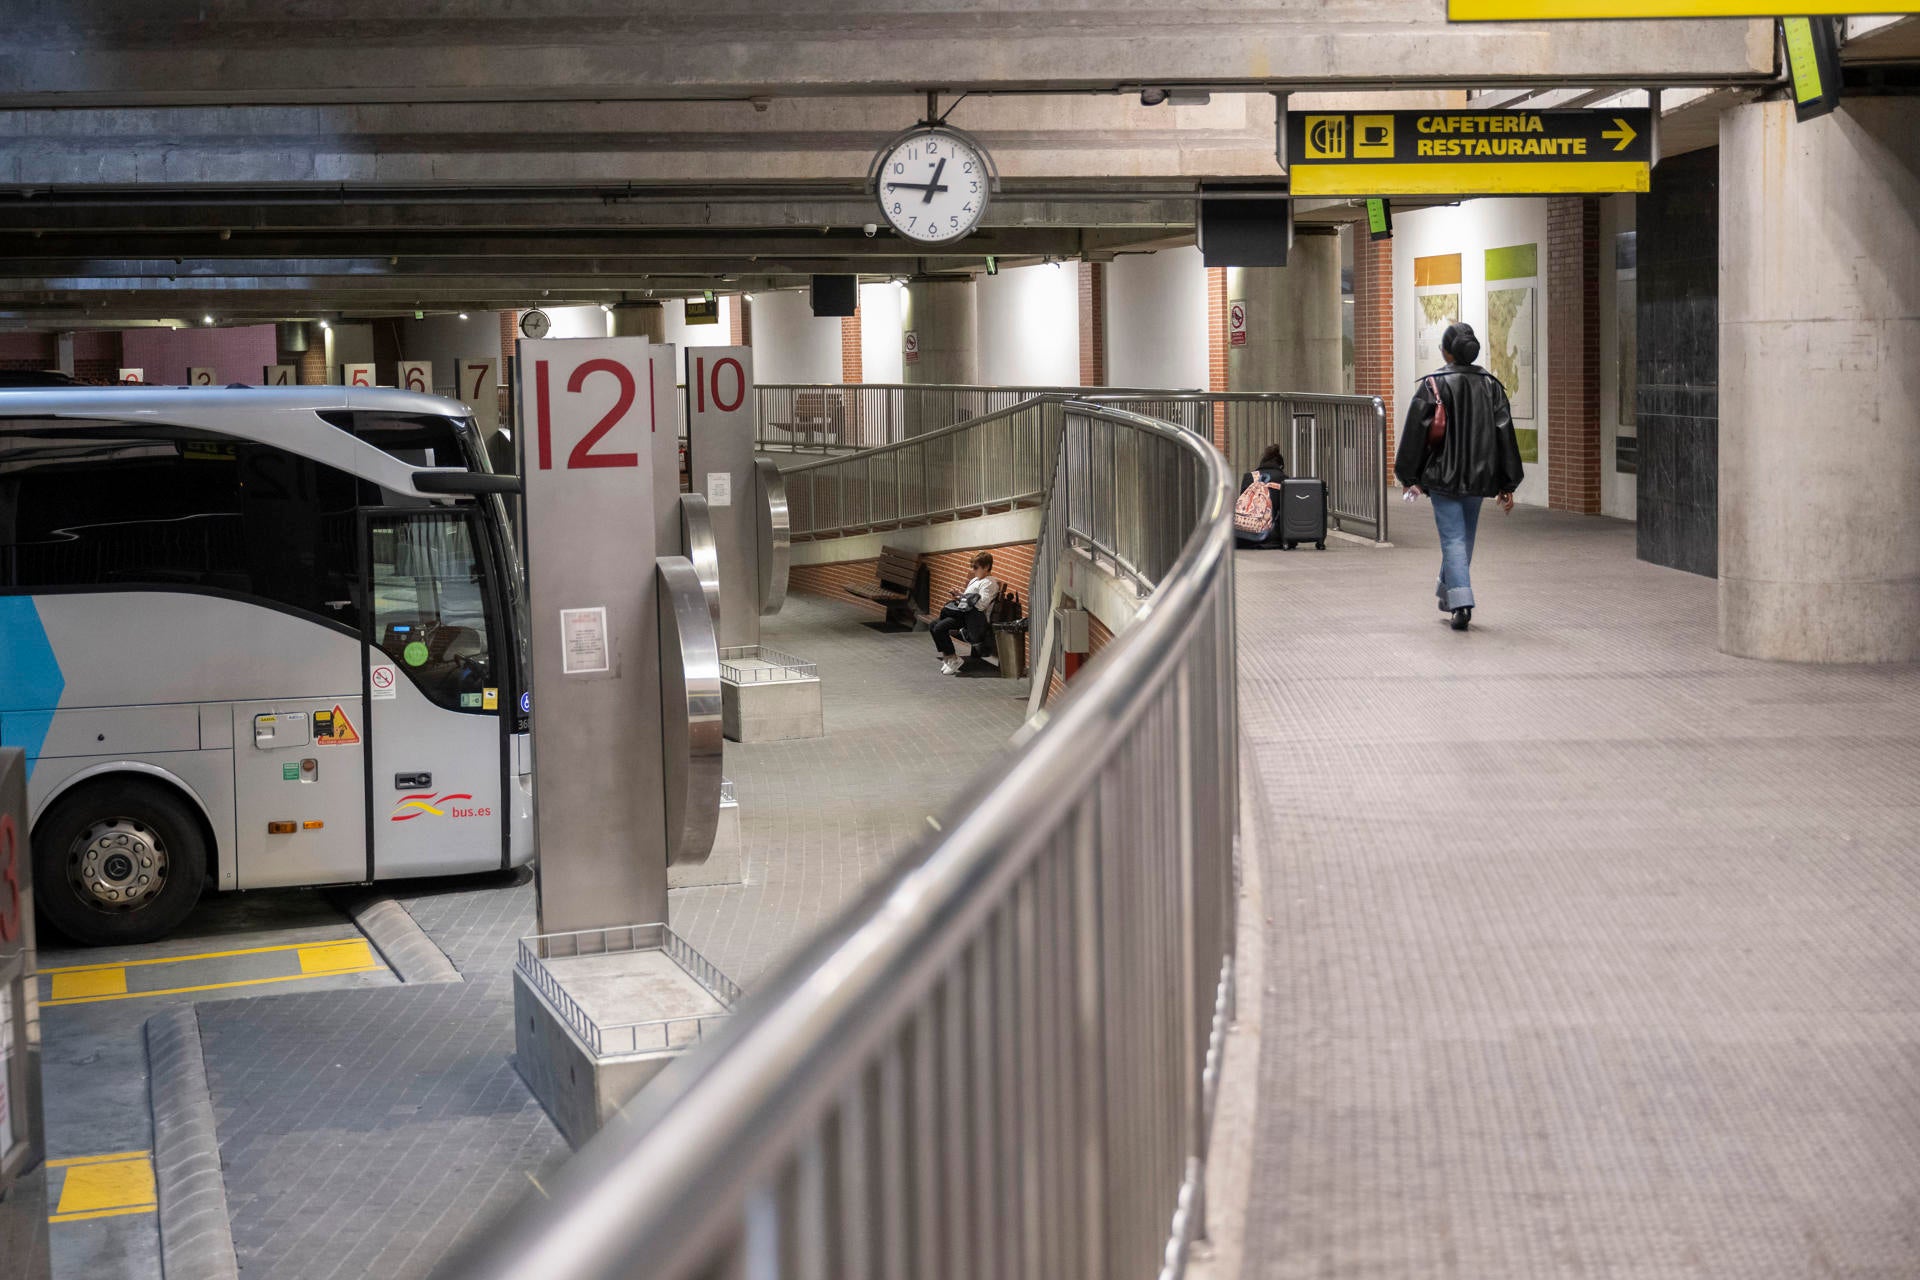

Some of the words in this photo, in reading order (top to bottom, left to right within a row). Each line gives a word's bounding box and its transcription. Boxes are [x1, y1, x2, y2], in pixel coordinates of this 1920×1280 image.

[1416, 112, 1544, 133] CAFETERÍA
[926, 142, 938, 154] 12
[1417, 138, 1587, 156] RESTAURANTE
[908, 148, 918, 160] 11
[893, 162, 904, 175] 10
[963, 161, 972, 174] 2
[969, 181, 978, 194] 3
[893, 202, 902, 215] 8
[962, 202, 972, 213] 4
[909, 216, 918, 228] 7
[928, 222, 938, 234] 6
[950, 216, 959, 228] 5
[352, 369, 370, 387] 5
[406, 367, 425, 393] 6
[467, 364, 489, 400] 7
[696, 357, 745, 413] 10
[535, 358, 638, 470] 12
[451, 806, 491, 818] bus.es
